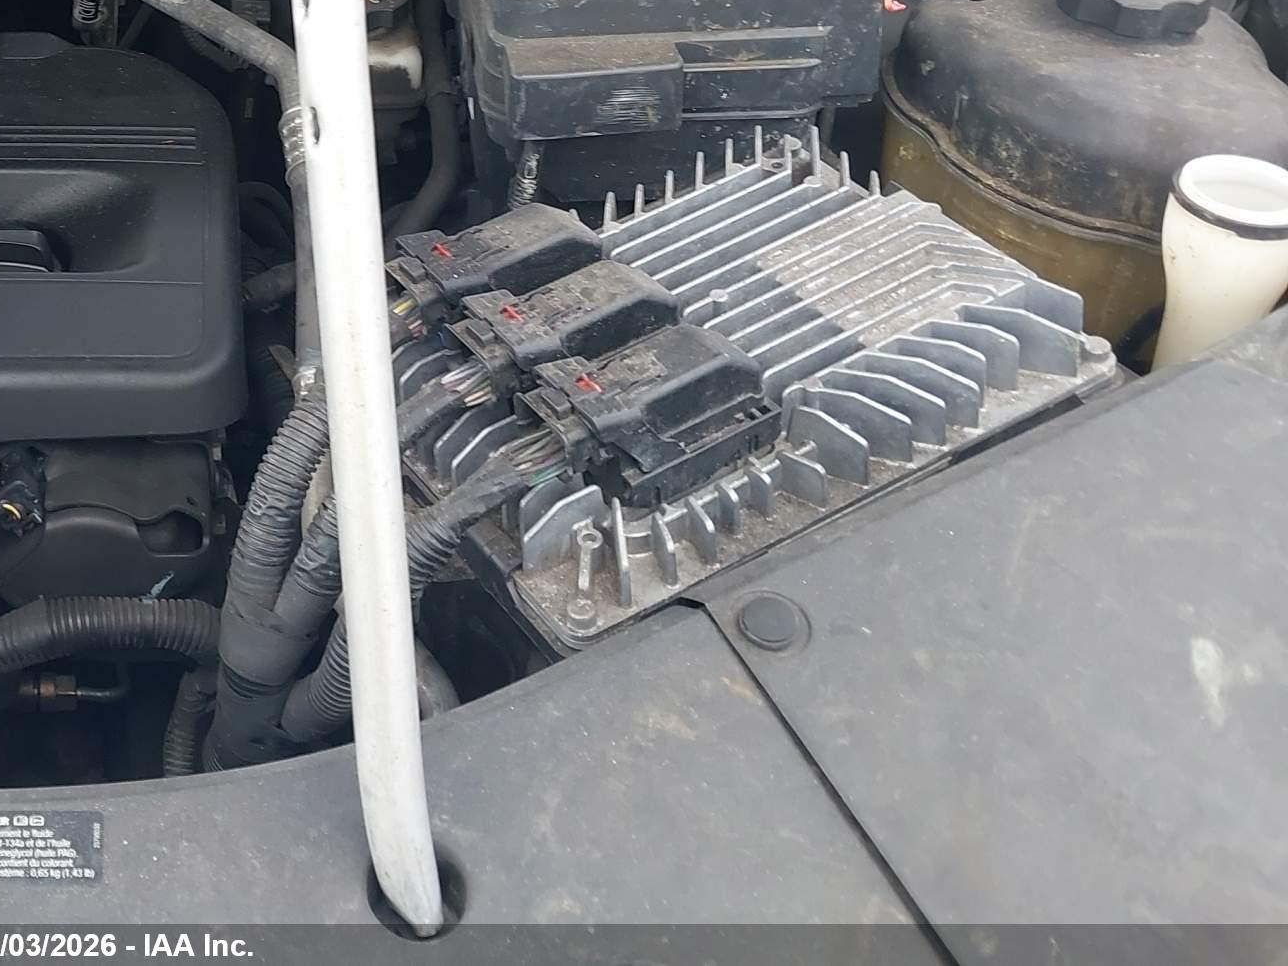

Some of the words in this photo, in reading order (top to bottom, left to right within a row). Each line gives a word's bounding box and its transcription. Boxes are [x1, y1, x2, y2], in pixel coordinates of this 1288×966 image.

[32, 829, 54, 838] fluide
[34, 849, 56, 858] (huile
[50, 869, 61, 879] kg
